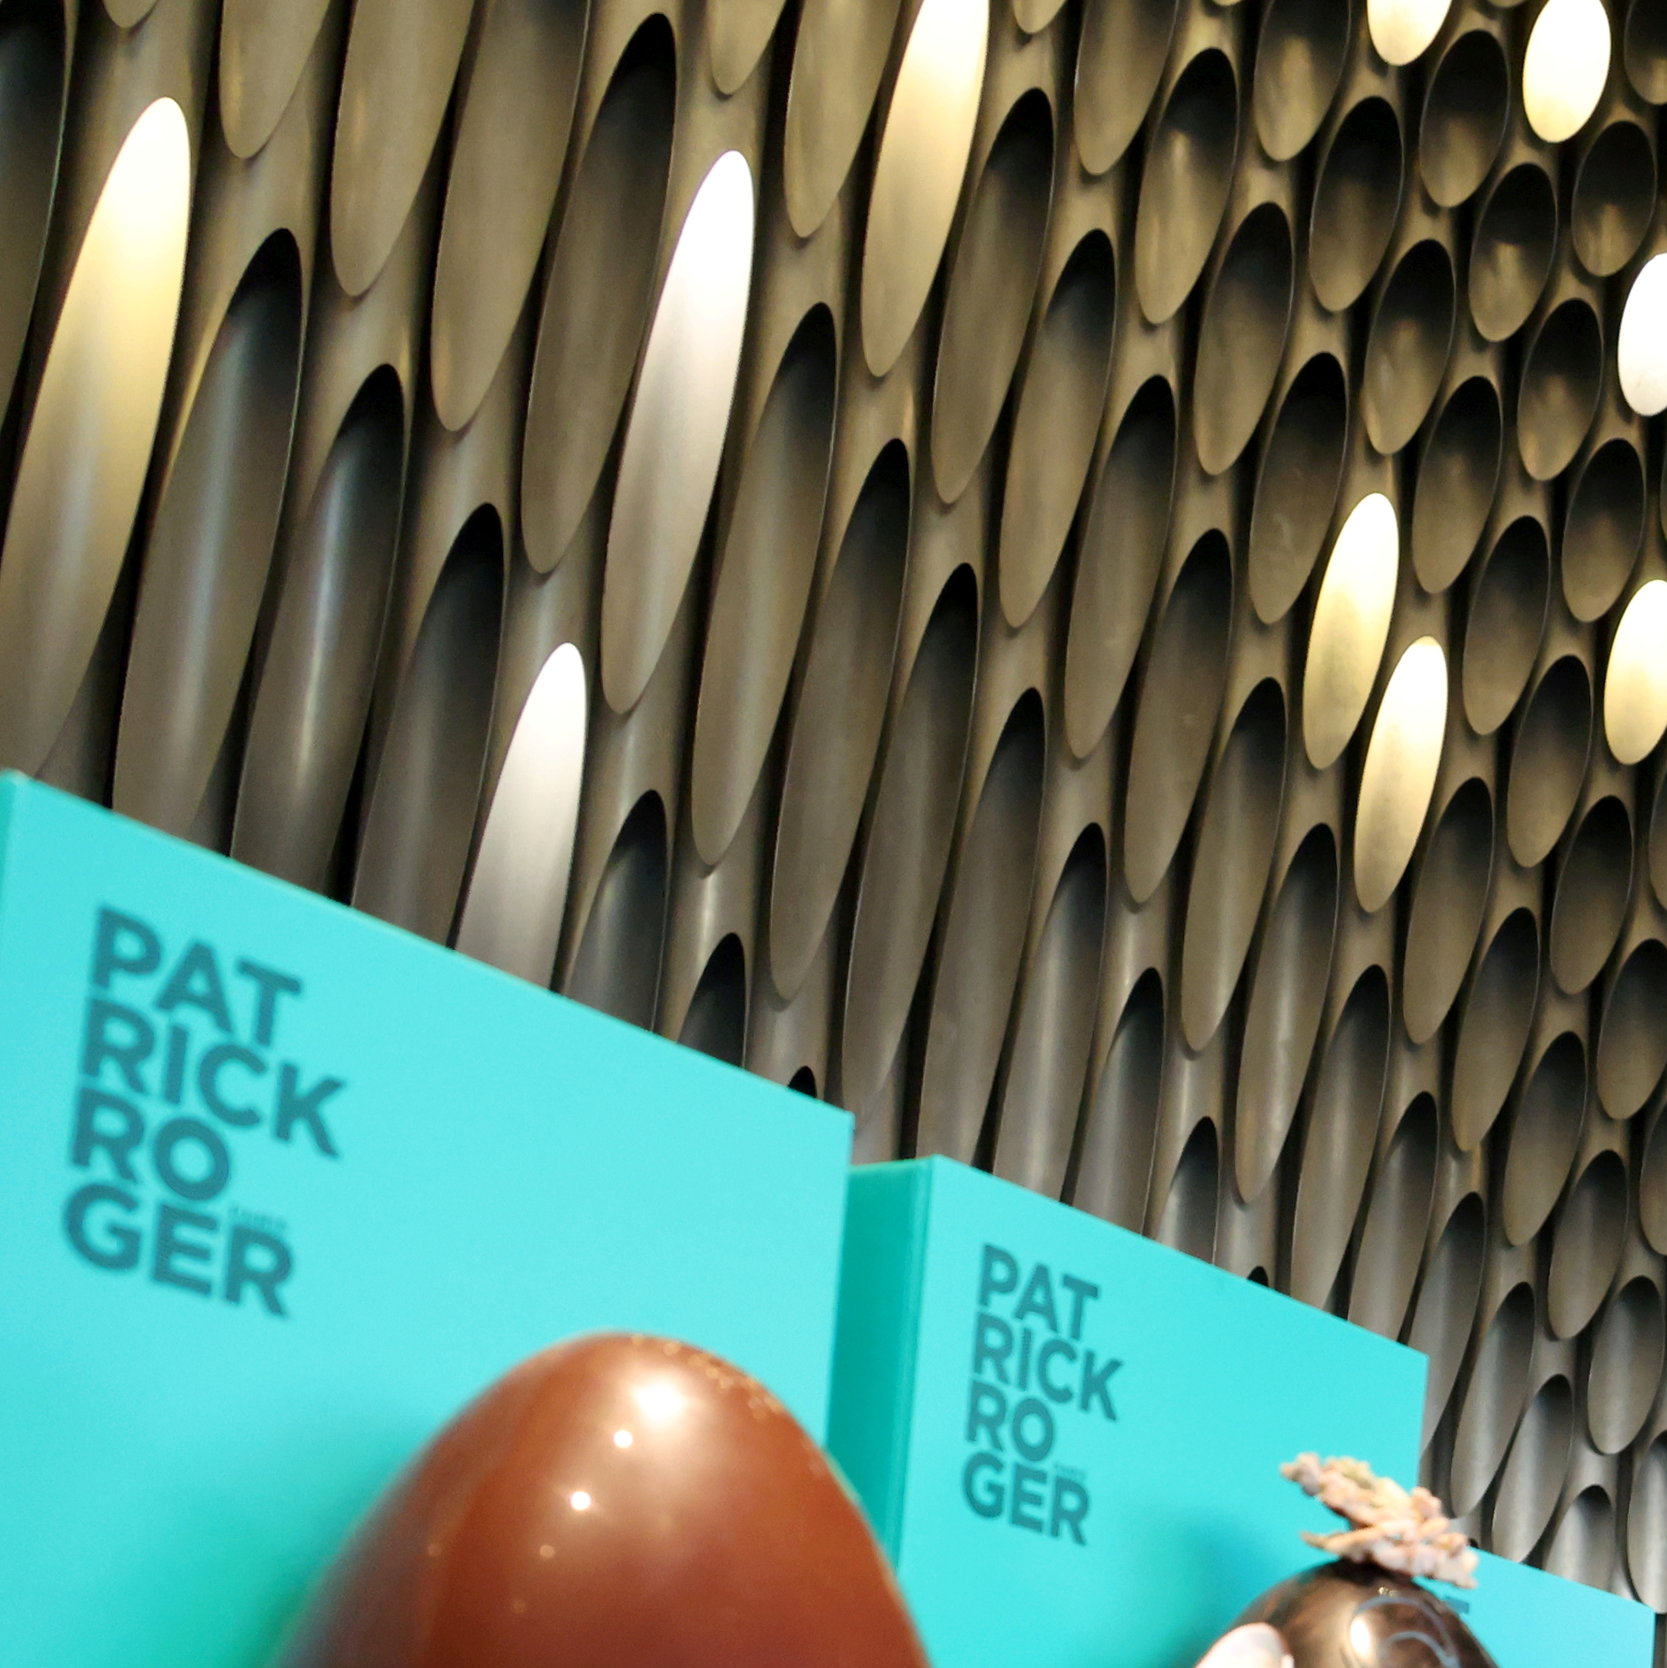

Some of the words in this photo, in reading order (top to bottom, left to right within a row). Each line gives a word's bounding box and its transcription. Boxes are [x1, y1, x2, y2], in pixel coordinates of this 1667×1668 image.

[93, 904, 303, 1046] PAT
[83, 1000, 347, 1159] RICK
[70, 1088, 231, 1201] RO
[63, 1183, 292, 1319] GER
[977, 1243, 1098, 1339] PAT
[967, 1380, 1054, 1461] RO
[973, 1311, 1125, 1421] RICK
[962, 1450, 1089, 1545] GER
